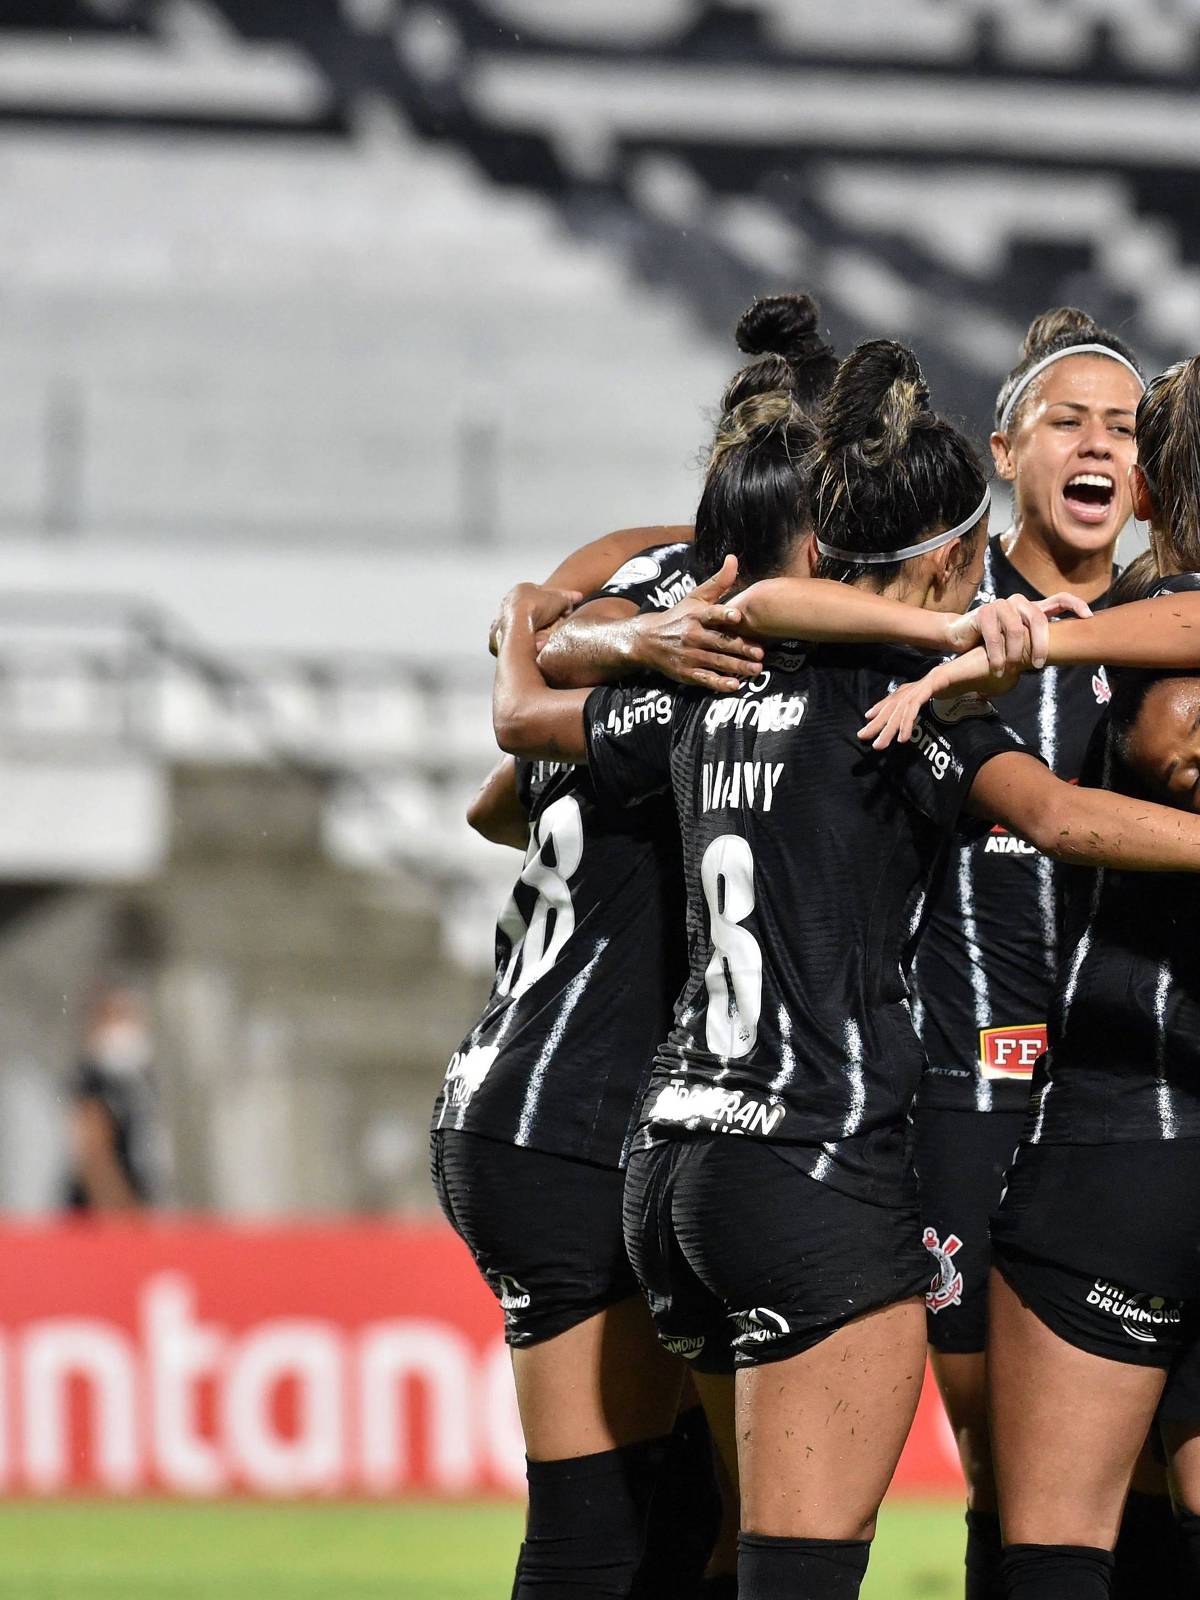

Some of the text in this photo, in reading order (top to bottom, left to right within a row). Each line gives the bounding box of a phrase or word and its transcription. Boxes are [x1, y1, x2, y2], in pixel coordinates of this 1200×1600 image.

[984, 836, 1042, 854] ATAC
[701, 833, 763, 1058] 8
[994, 1038, 1042, 1065] FE
[0, 1270, 527, 1492] ntan
